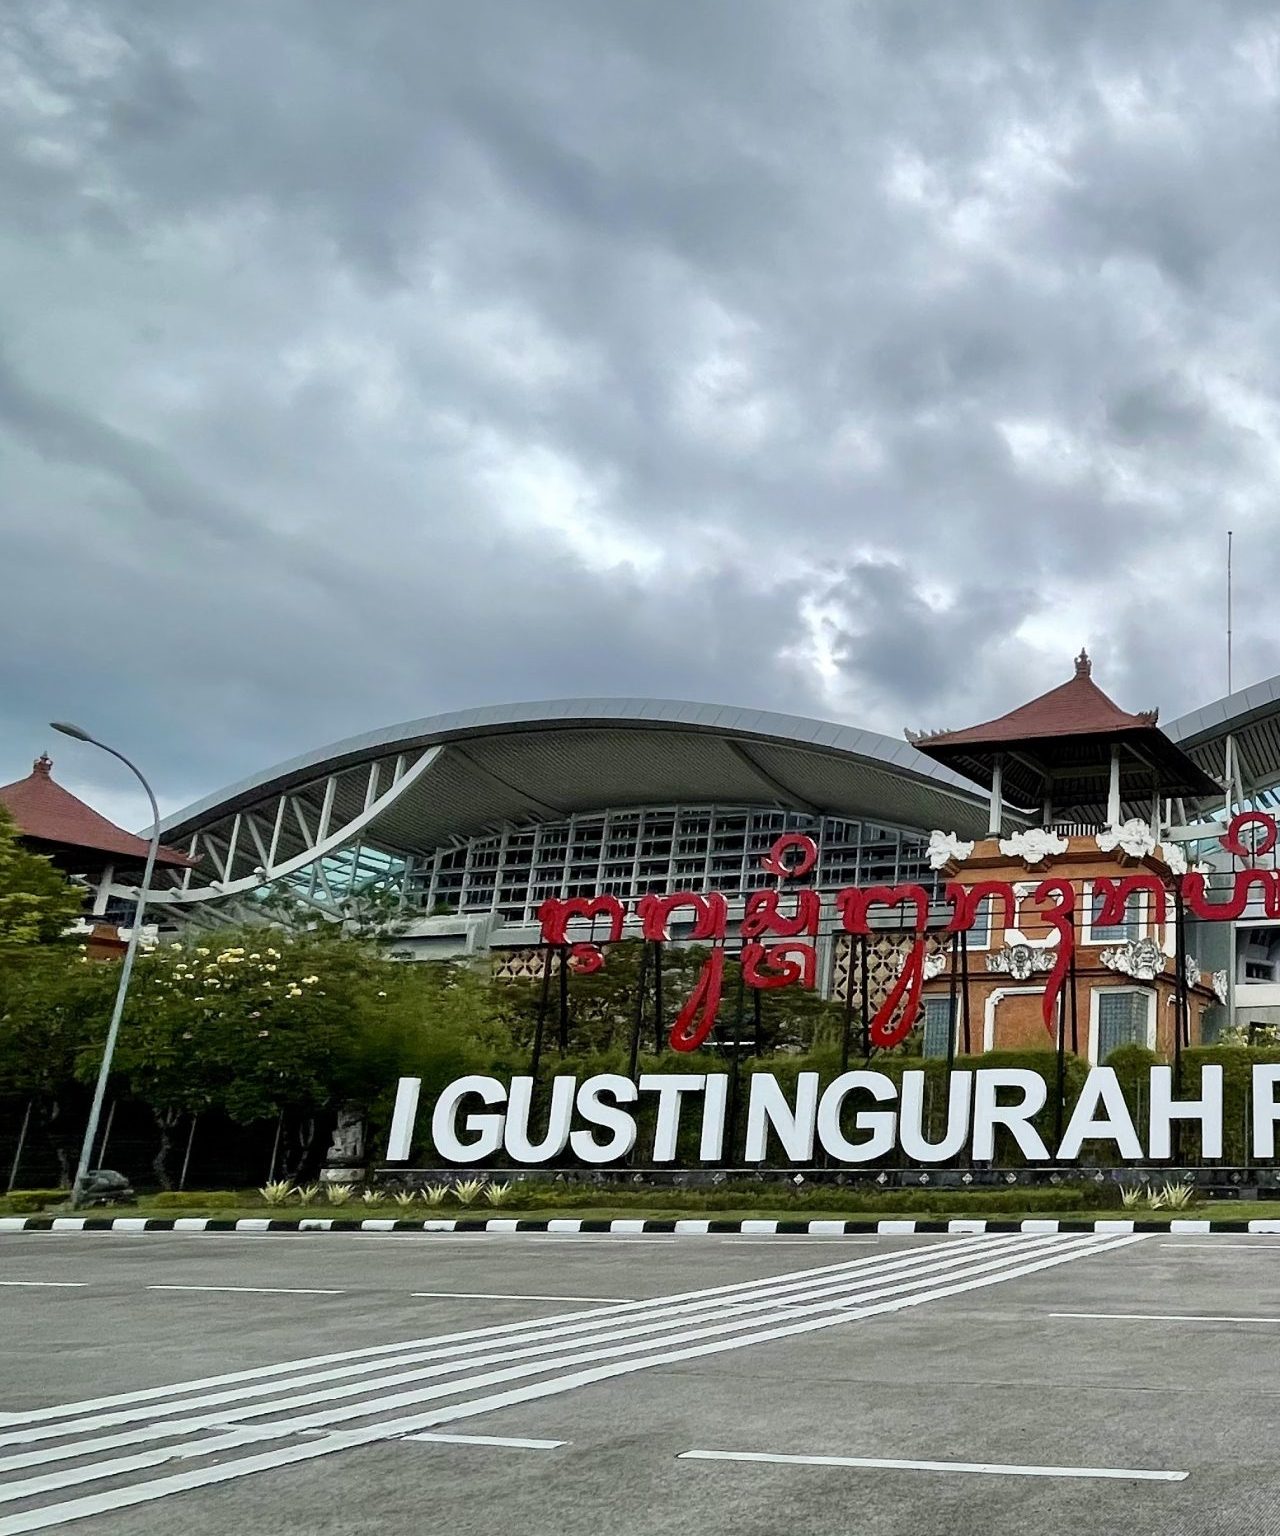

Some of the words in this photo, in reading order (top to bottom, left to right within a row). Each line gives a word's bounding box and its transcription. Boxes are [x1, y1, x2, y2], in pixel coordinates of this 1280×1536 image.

[386, 1077, 422, 1161] I
[432, 1073, 729, 1163] GUSTI
[744, 1064, 1223, 1163] NGURAH
